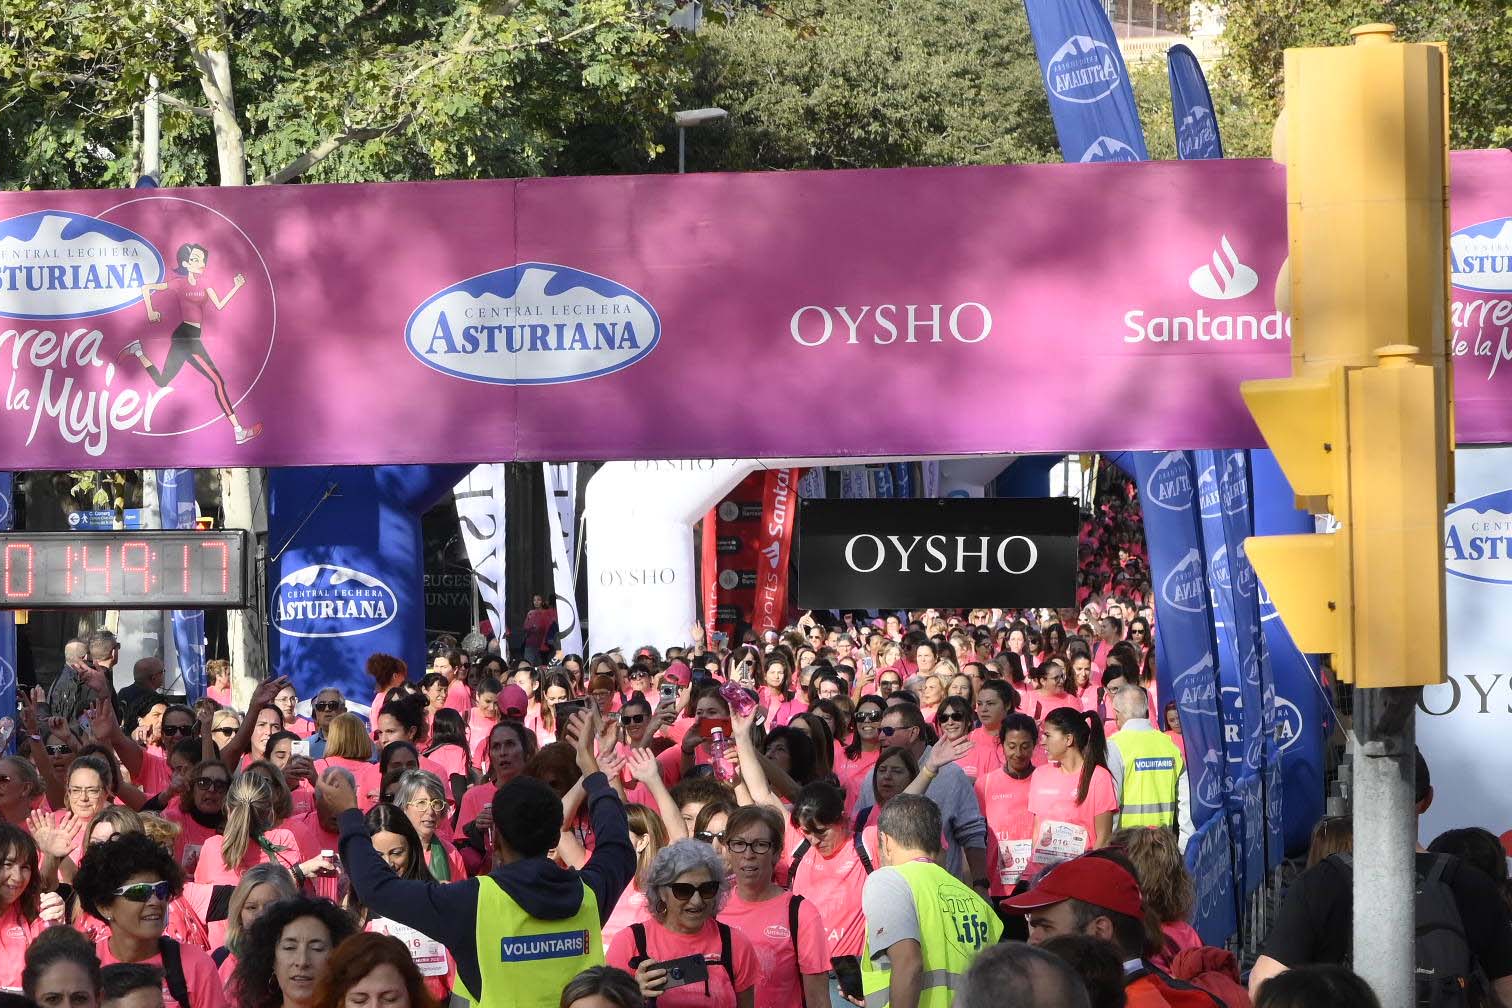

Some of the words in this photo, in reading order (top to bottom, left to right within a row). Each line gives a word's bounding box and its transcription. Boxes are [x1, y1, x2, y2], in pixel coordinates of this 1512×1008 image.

[66, 246, 140, 259] LECHERA
[464, 305, 543, 319] CENTRAL
[551, 302, 632, 317] LECHERA
[790, 302, 993, 347] OYSHO
[424, 310, 641, 355] ASTURIANA
[1123, 309, 1292, 343] Santand
[5, 371, 31, 412] la
[25, 362, 175, 458] Mujer
[844, 533, 1039, 575] OYSHO
[600, 567, 676, 586] OYSHO
[287, 589, 331, 599] CENTRAL
[275, 598, 388, 621] ASTURIANA
[503, 936, 583, 957] VOLUNTARIS
[951, 914, 988, 952] Life
